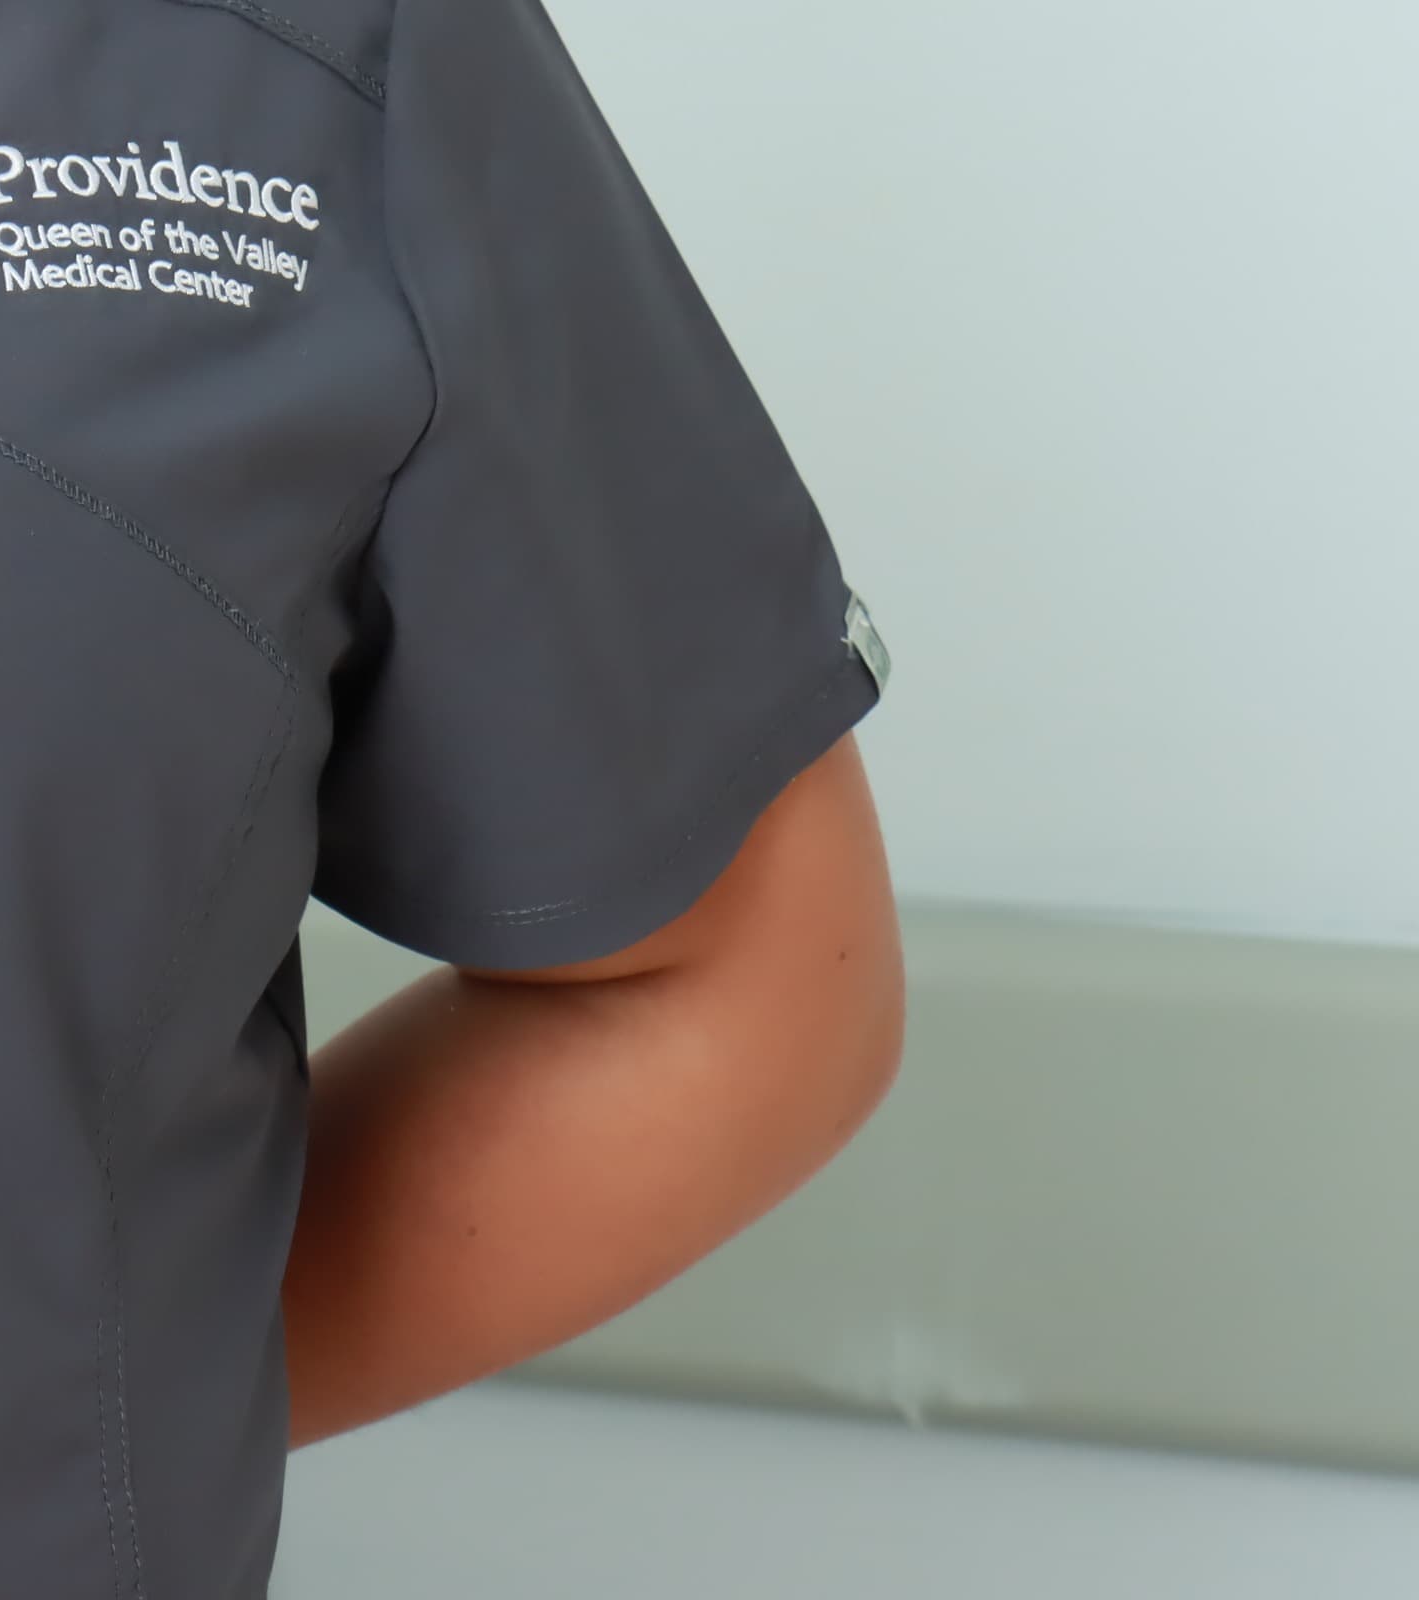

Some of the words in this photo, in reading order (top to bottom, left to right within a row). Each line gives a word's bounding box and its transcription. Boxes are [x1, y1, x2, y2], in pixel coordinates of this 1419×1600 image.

[2, 254, 142, 292] Medical
[149, 260, 254, 308] Center
[120, 219, 156, 252] of
[164, 221, 219, 260] the
[223, 231, 309, 291] Valley
